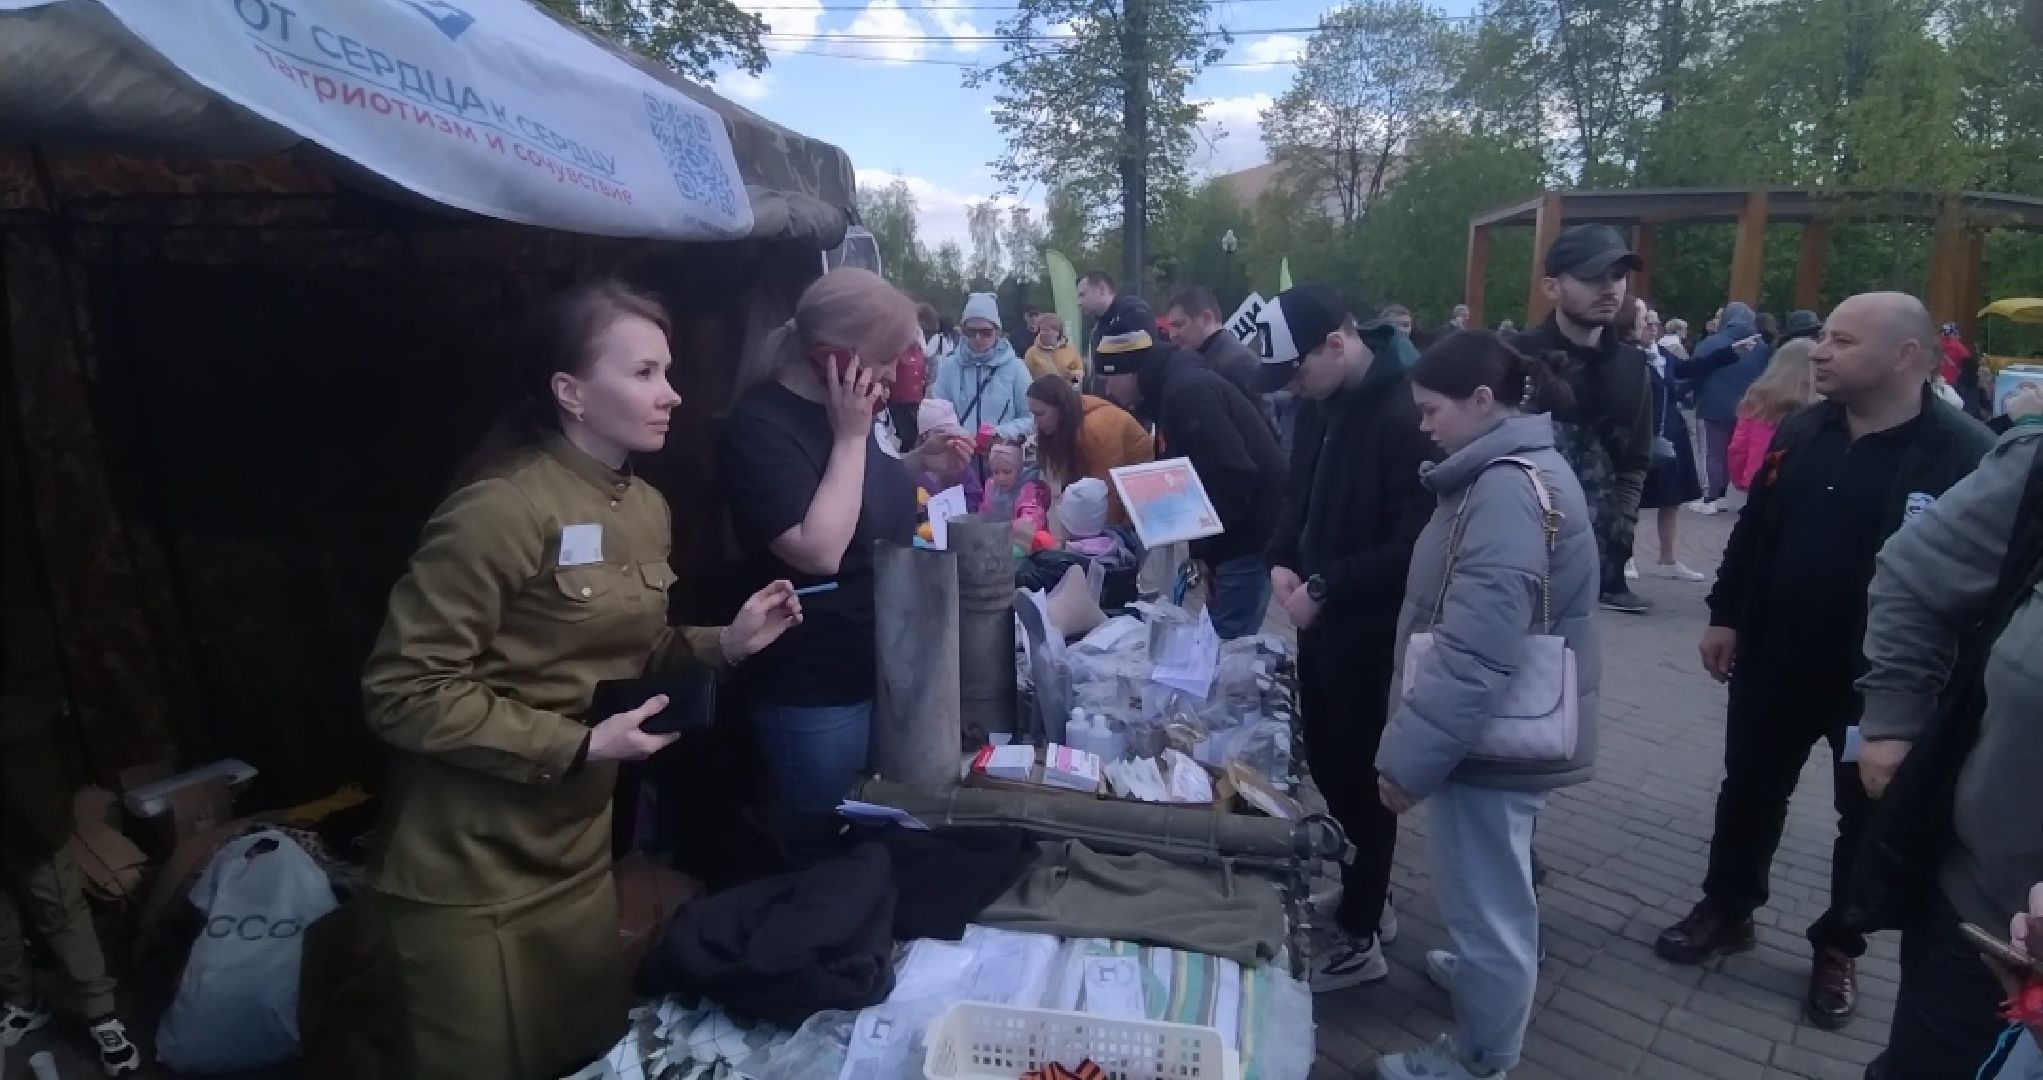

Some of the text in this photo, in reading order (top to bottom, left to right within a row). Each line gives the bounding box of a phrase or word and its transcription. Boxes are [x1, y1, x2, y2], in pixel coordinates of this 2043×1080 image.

[234, 0, 296, 41] ОТ
[311, 25, 487, 115] СЕРДЦА
[516, 114, 616, 177] СЕРДЦУ
[513, 143, 632, 205] сочувствие
